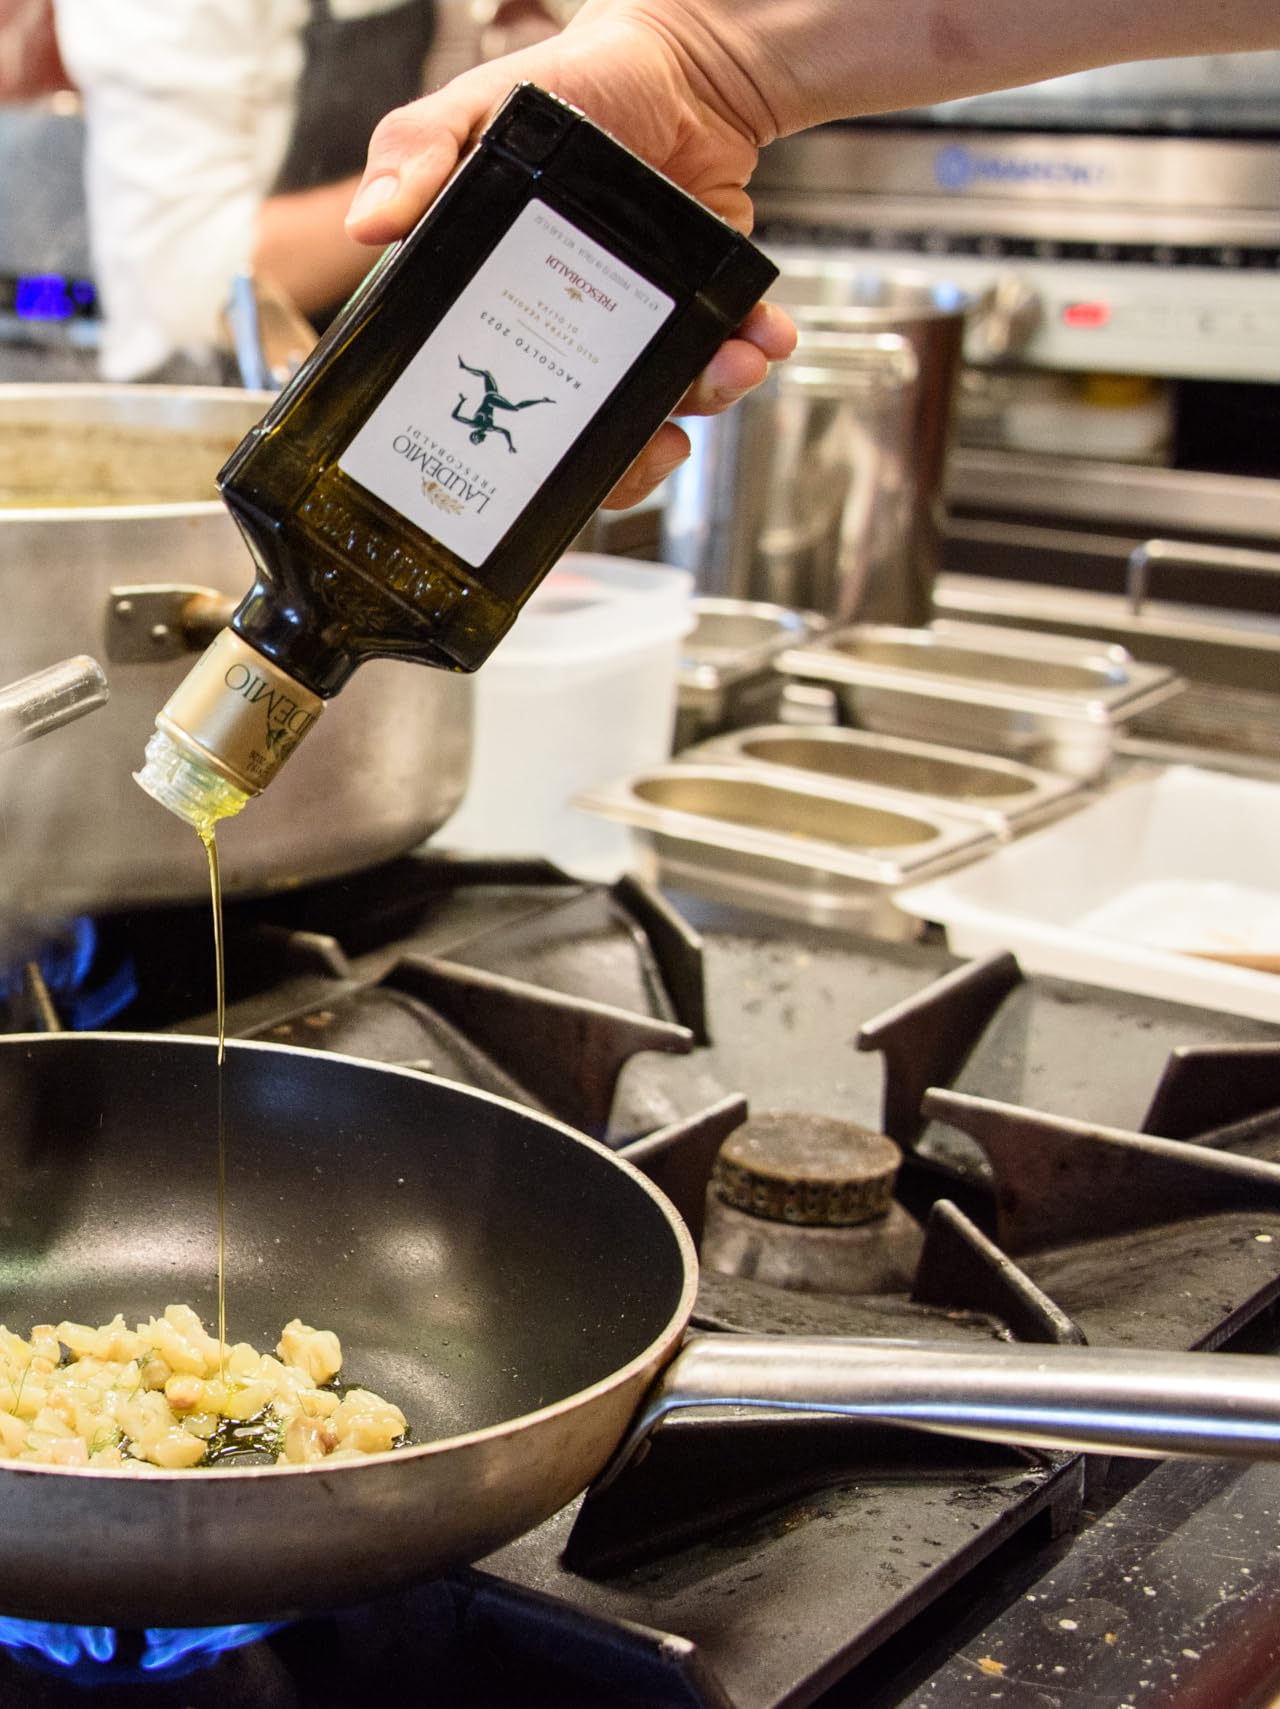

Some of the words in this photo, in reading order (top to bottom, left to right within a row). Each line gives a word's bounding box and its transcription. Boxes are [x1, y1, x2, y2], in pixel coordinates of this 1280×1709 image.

[544, 253, 617, 312] FRESCOBALDI
[480, 311, 511, 337] 2023
[515, 337, 582, 390] RACCOLTO
[392, 436, 490, 514] LAUDEMIO
[405, 424, 496, 495] FRESCOBALDI
